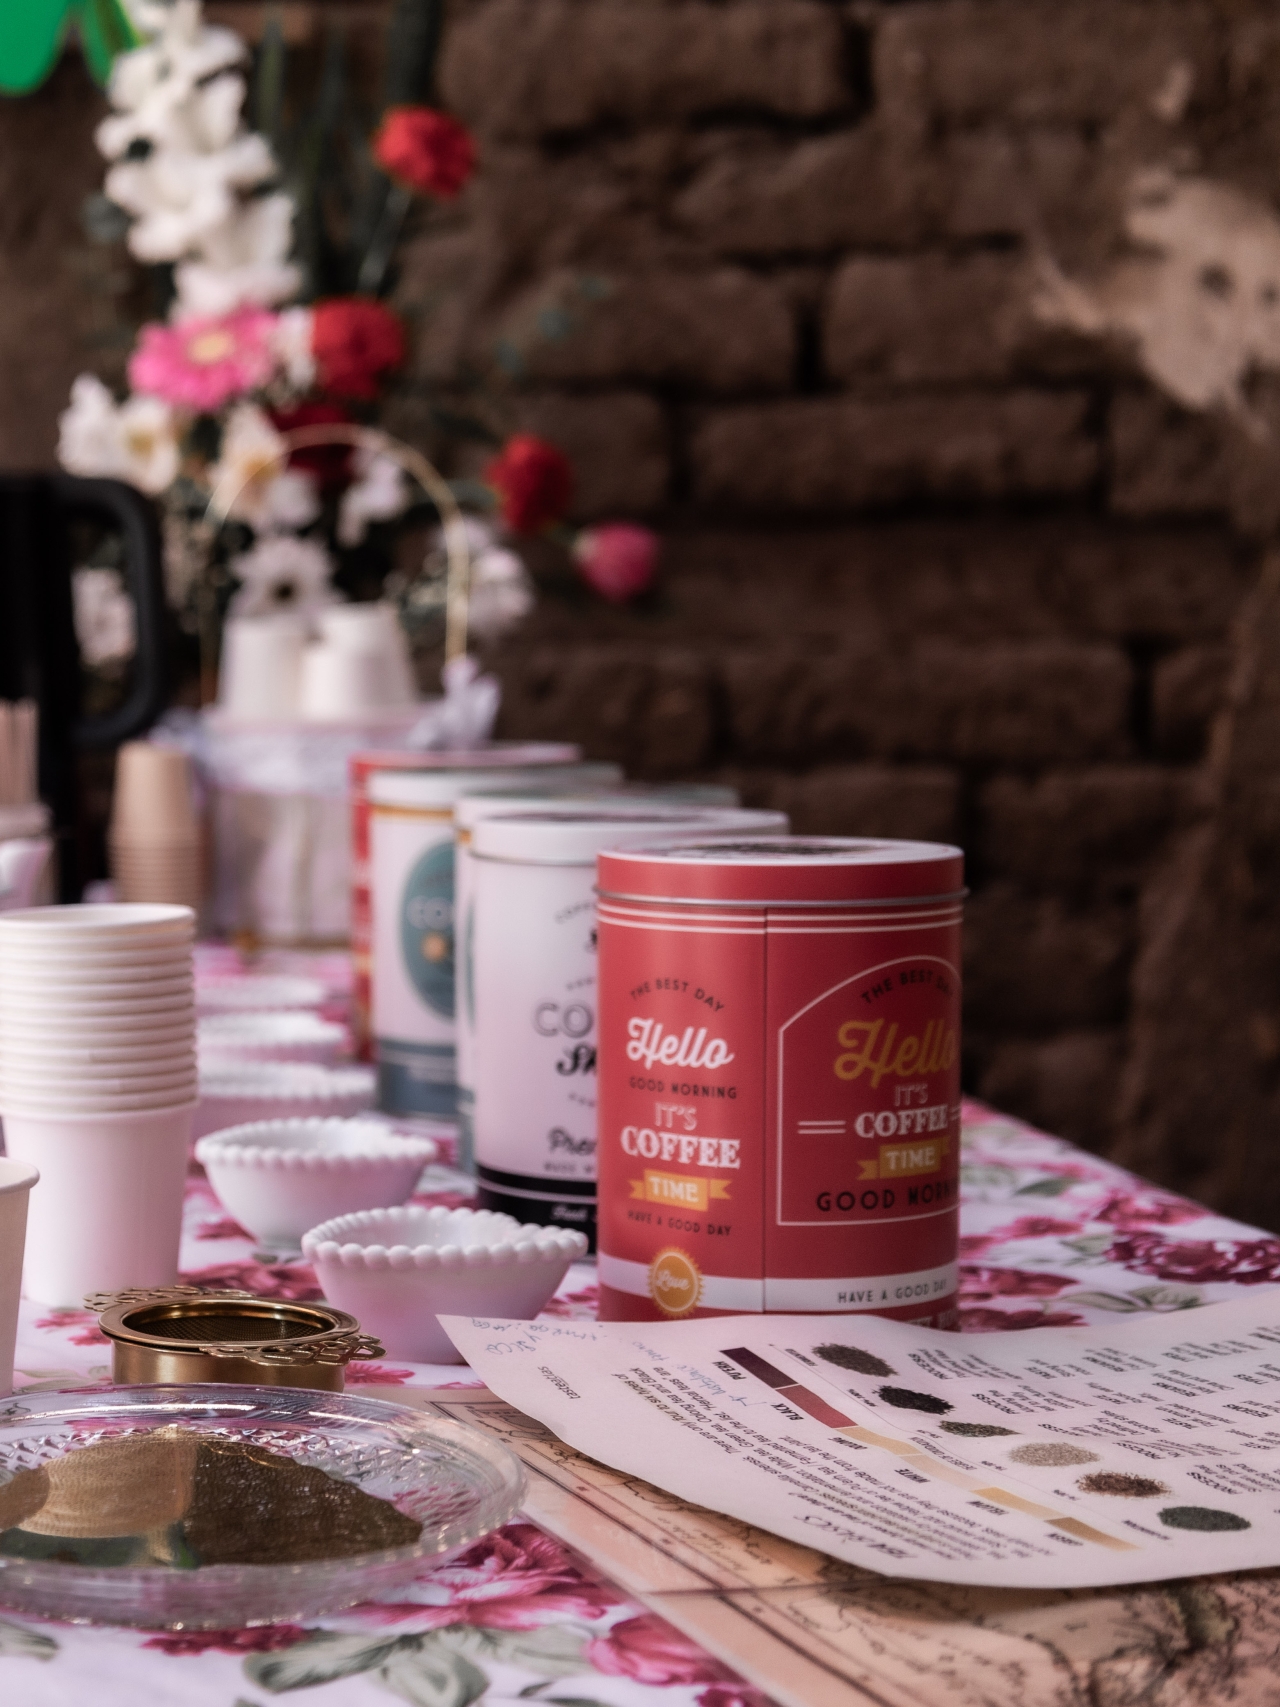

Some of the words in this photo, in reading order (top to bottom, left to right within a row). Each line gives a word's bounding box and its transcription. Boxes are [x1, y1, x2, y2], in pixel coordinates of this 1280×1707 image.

[861, 977, 893, 1004] THE
[899, 968, 933, 986] BEST
[936, 976, 952, 995] DA
[630, 981, 651, 1001] THE
[655, 977, 689, 993] BEST
[694, 987, 725, 1012] DAY
[626, 1016, 735, 1070] Hello
[833, 1018, 956, 1090] Hello
[629, 1076, 665, 1093] GOOD
[671, 1082, 738, 1099] MORNING
[894, 1082, 929, 1107] IT'S
[654, 1101, 698, 1131] IT'S
[854, 1103, 949, 1140] COFFEE
[621, 1125, 741, 1170] COFFEE
[884, 1146, 936, 1171] TIME
[649, 1176, 700, 1204] TIME
[816, 1188, 895, 1212] GOOD
[627, 1210, 652, 1224] HAVE
[656, 1216, 663, 1226] A
[668, 1217, 701, 1234] GOOD
[707, 1223, 732, 1237] DAY
[837, 1289, 874, 1304] HAVE
[881, 1290, 888, 1301] A
[895, 1283, 930, 1300] GOOD
[1082, 1356, 1125, 1372] REGIONS
[1162, 1352, 1190, 1362] TYPES
[652, 1367, 672, 1376] are
[712, 1361, 747, 1380] PU'ERH
[907, 1353, 949, 1380] PROCESS
[1025, 1366, 1056, 1379] TASTE
[1045, 1365, 1076, 1377] Strong
[1167, 1369, 1192, 1378] India
[628, 1367, 658, 1384] Black
[1152, 1372, 1197, 1387] commonly
[1233, 1374, 1269, 1385] TYPES
[538, 1366, 582, 1400] tasteatlas
[623, 1380, 652, 1395] types
[647, 1383, 673, 1394] and
[1152, 1382, 1197, 1397] REGIONS
[1191, 1386, 1216, 1394] Most
[1202, 1381, 1235, 1391] China
[987, 1389, 1006, 1397] the
[1010, 1391, 1032, 1401] fully
[1016, 1384, 1047, 1398] during
[643, 1395, 663, 1404] six
[665, 1394, 686, 1403] tea
[971, 1393, 1017, 1414] PROCESS
[1001, 1397, 1036, 1413] Allowing
[1042, 1398, 1076, 1409] oxidize
[1094, 1394, 1127, 1405] TASTE
[663, 1410, 687, 1421] four
[678, 1403, 713, 1423] Oolong
[712, 1411, 735, 1421] list.
[770, 1403, 805, 1421] BLACK
[1222, 1404, 1271, 1418] REGIONS
[679, 1421, 704, 1431] only
[728, 1421, 749, 1429] the
[1102, 1422, 1146, 1435] Defined
[1124, 1420, 1162, 1433] regional
[1161, 1417, 1198, 1429] TASTE
[698, 1431, 719, 1439] are
[723, 1432, 755, 1448] Green
[751, 1434, 772, 1443] tea
[777, 1435, 811, 1446] plant.
[712, 1440, 742, 1454] There
[801, 1445, 823, 1453] tea
[827, 1437, 868, 1450] OOLONG
[909, 1436, 946, 1455] OXIDATION
[1112, 1441, 1162, 1459] PROCESS
[763, 1442, 815, 1464] Fermented
[817, 1452, 838, 1460] the
[767, 1456, 798, 1469] White
[832, 1459, 860, 1472] from
[946, 1459, 978, 1470] DEGREE
[816, 1466, 838, 1475] tea
[893, 1468, 930, 1483] WHITE
[776, 1474, 820, 1492] Camellia
[795, 1469, 853, 1496] fermentation:
[831, 1474, 868, 1490] Pu'erh
[853, 1471, 882, 1485] made
[1185, 1472, 1238, 1494] PROCESS
[877, 1485, 902, 1493] not
[847, 1495, 875, 1504] and
[873, 1494, 896, 1502] tea
[915, 1500, 941, 1510] they
[822, 1506, 846, 1514] are
[891, 1502, 921, 1516] Yellow
[967, 1500, 1006, 1515] YELLOW
[840, 1513, 862, 1521] tea
[935, 1509, 982, 1528] because
